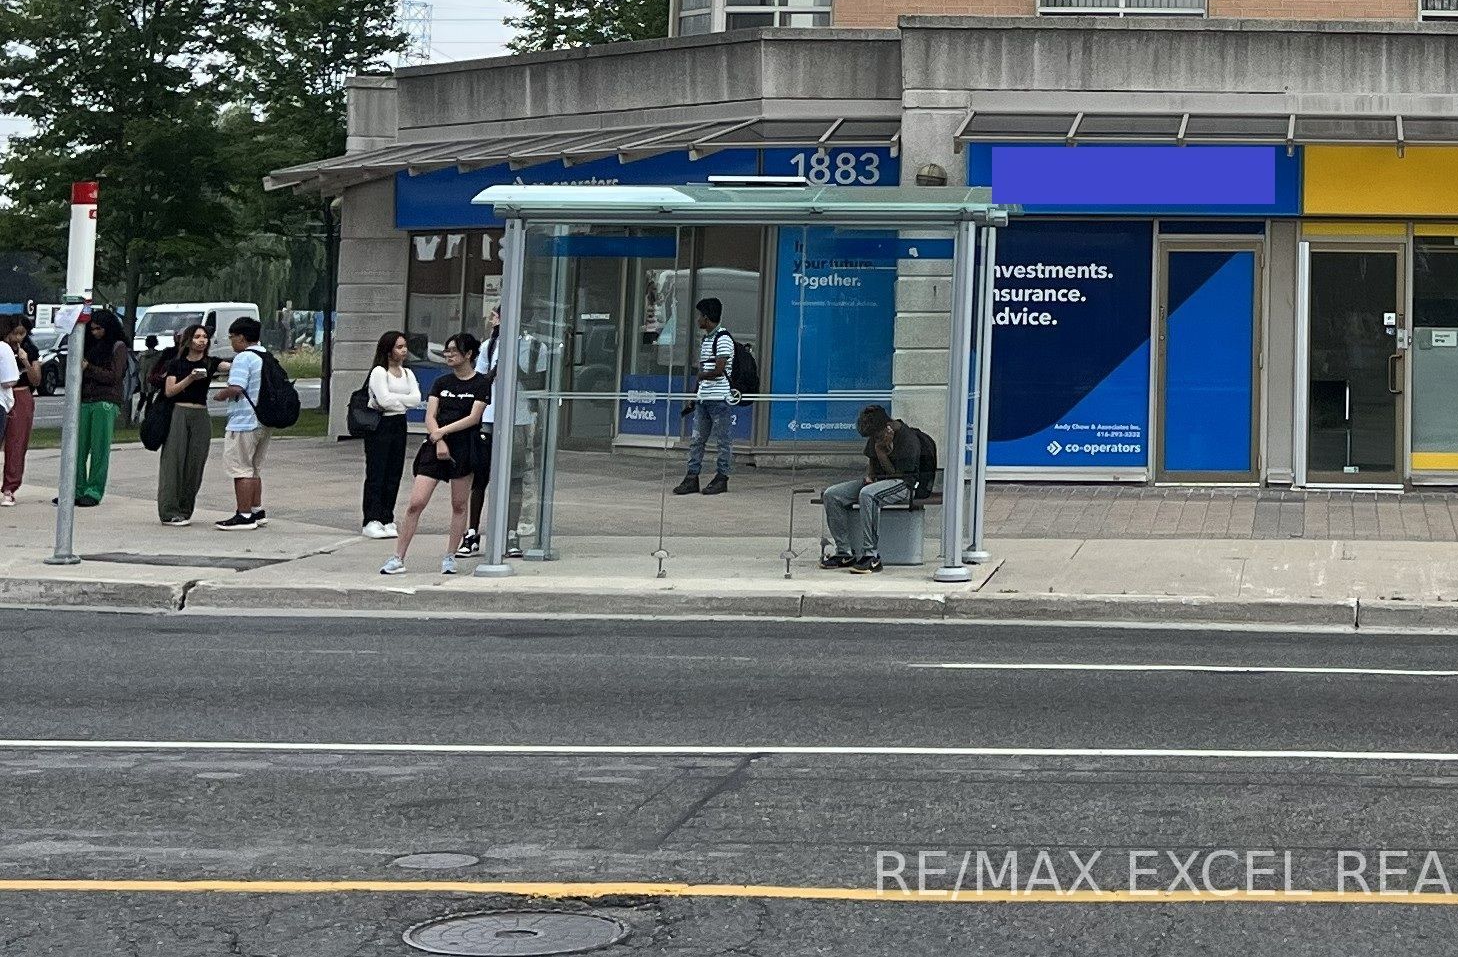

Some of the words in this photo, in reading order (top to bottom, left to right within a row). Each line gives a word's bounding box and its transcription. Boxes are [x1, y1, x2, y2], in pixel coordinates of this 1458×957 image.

[789, 152, 880, 185] 1883
[993, 262, 1114, 279] nvestments.
[792, 272, 863, 290] Together.
[992, 288, 1087, 303] nsurance.
[625, 405, 657, 421] Advice.
[1065, 443, 1141, 456] co-operators
